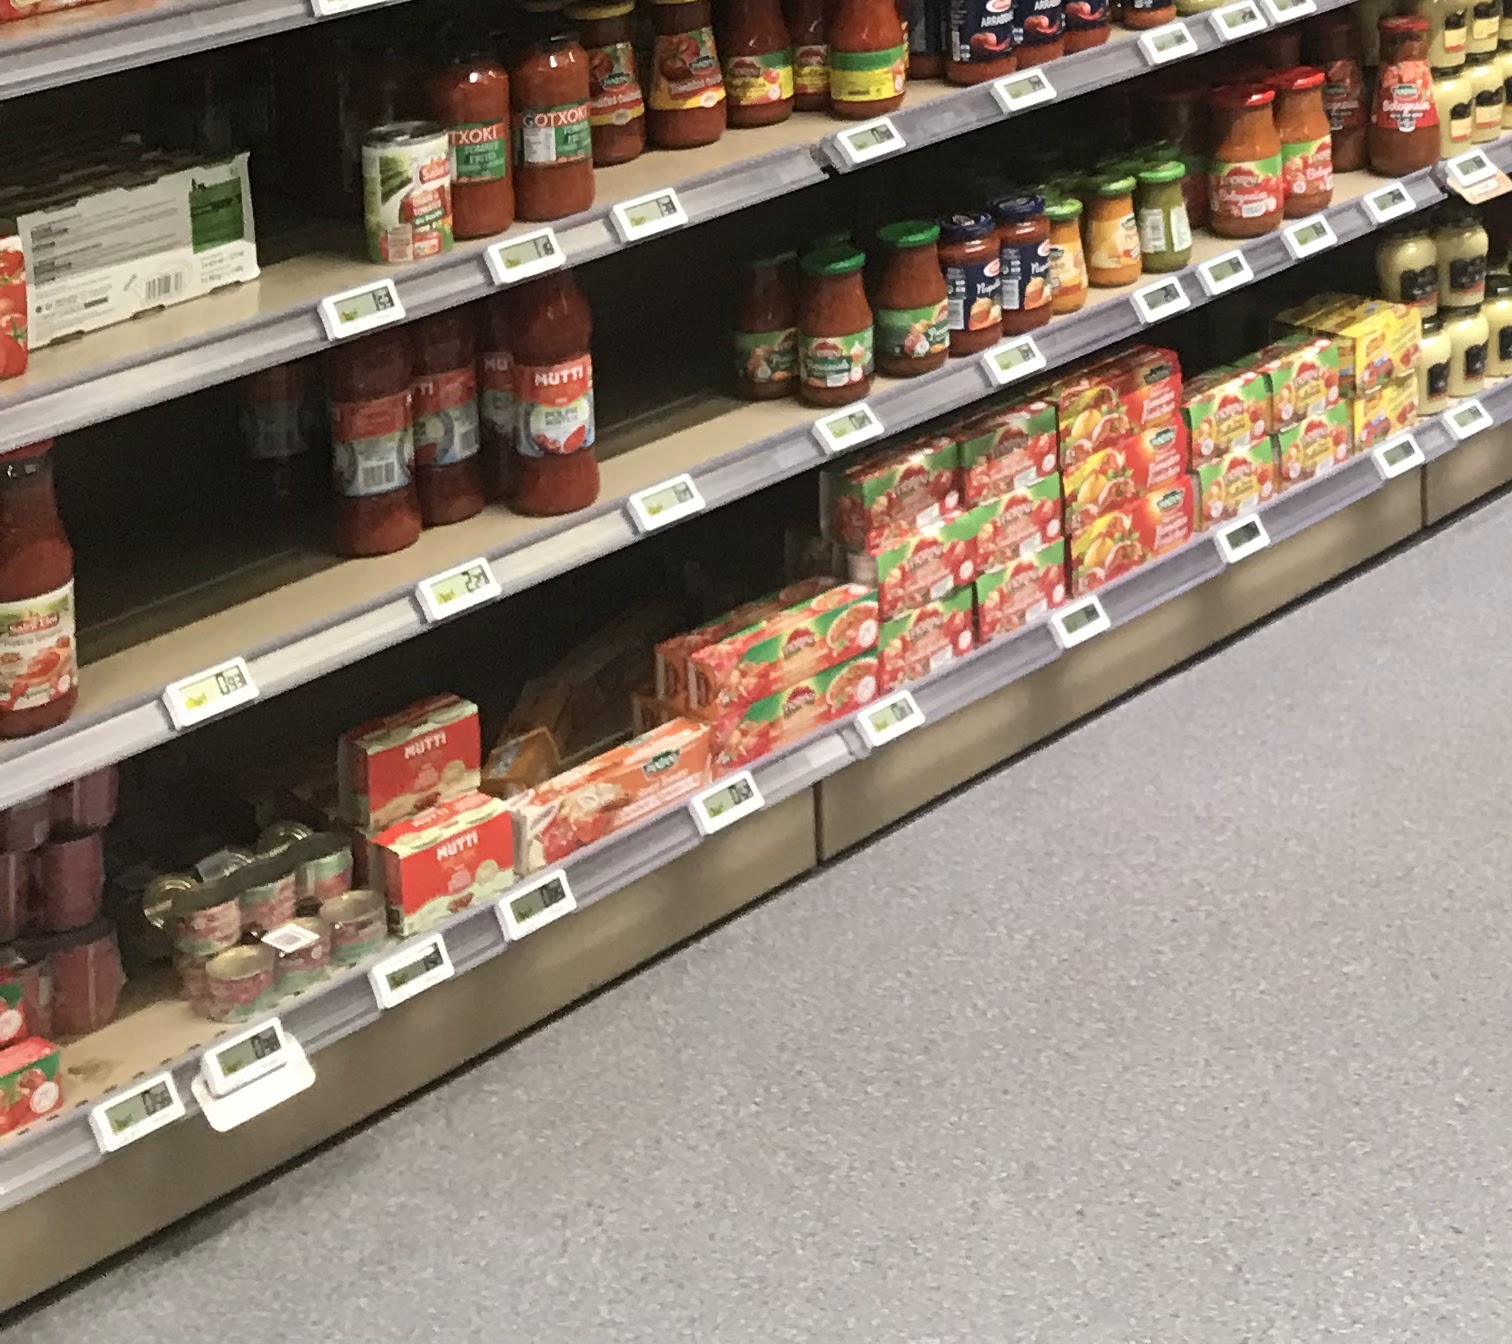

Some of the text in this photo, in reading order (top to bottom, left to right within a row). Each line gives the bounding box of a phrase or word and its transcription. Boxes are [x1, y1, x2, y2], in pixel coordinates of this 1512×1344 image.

[523, 103, 590, 128] GOTXOKI
[450, 125, 499, 145] TXOKI
[535, 365, 583, 387] MUTTI
[405, 732, 447, 759] MUTTI
